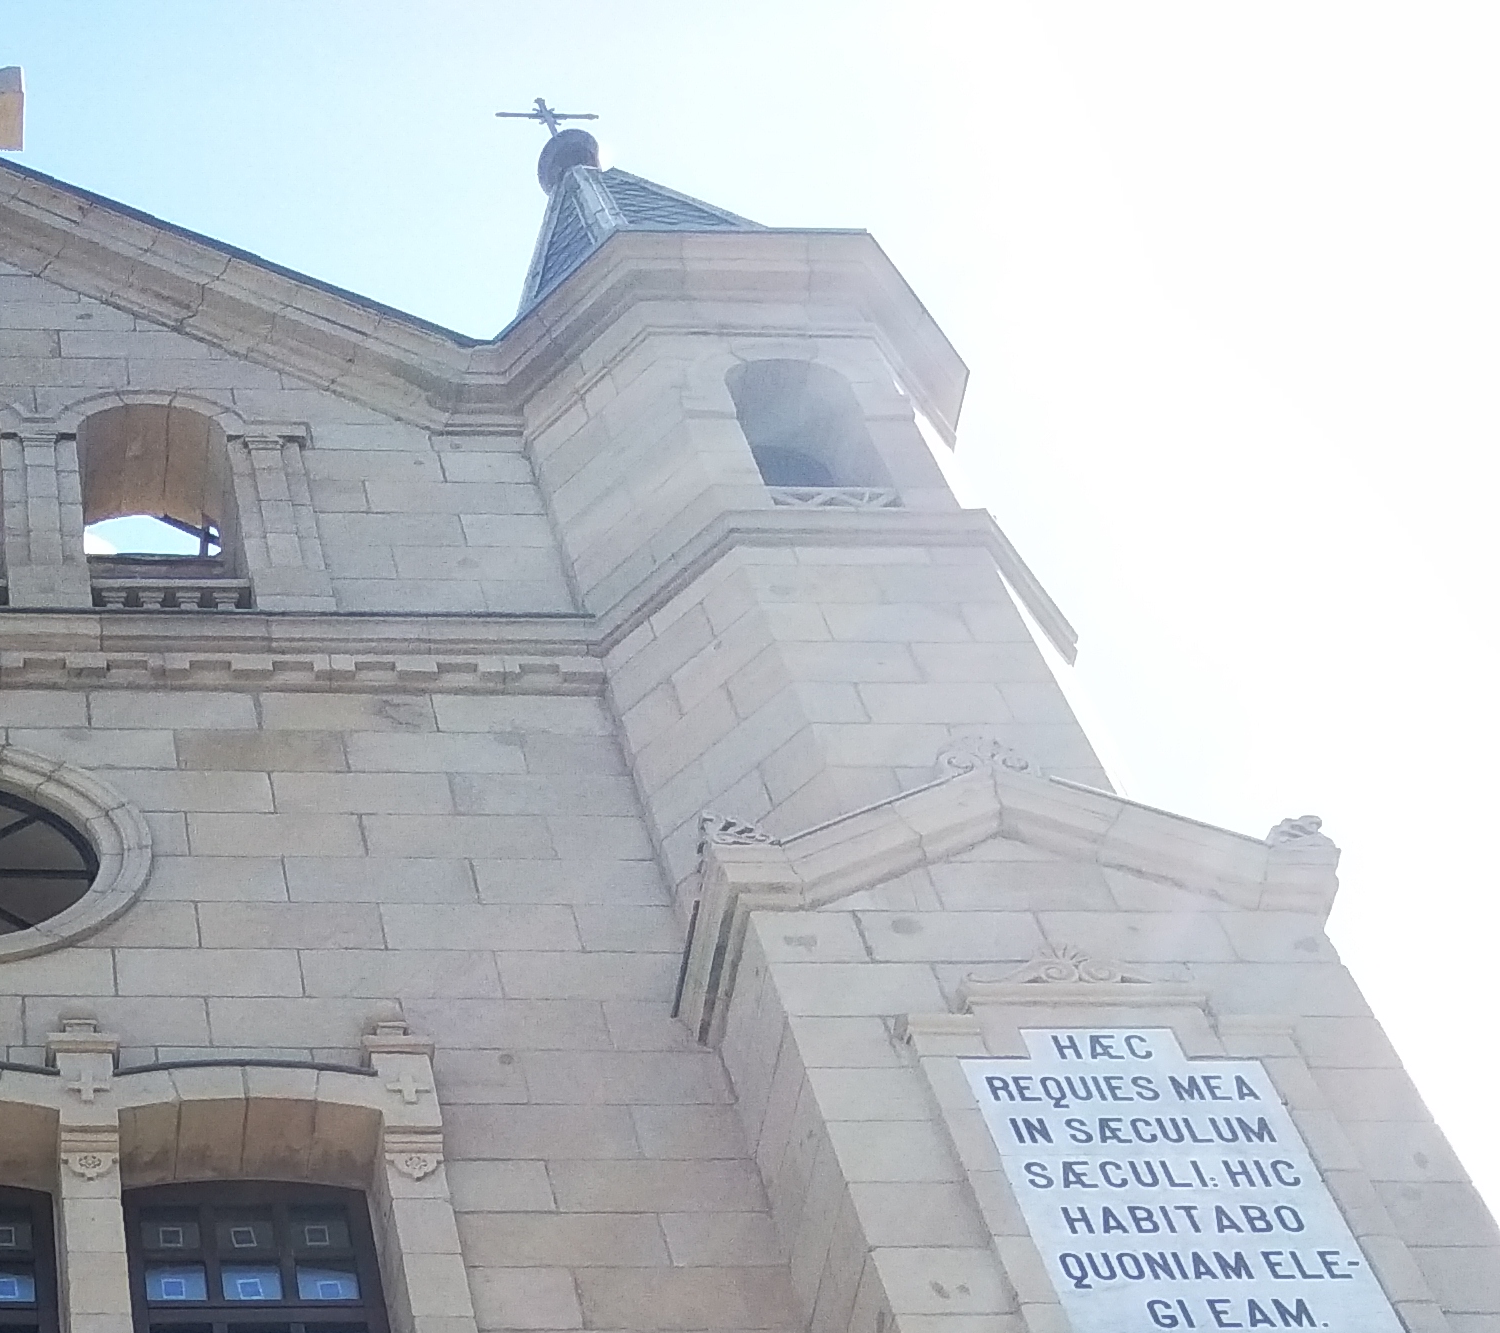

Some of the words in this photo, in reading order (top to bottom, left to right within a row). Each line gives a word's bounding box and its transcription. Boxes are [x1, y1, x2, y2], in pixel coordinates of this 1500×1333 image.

[1051, 1034, 1153, 1060] HÆC
[985, 1075, 1161, 1108] REQUIES
[1168, 1075, 1261, 1102] MEA
[1009, 1118, 1054, 1144] IN
[1064, 1117, 1277, 1144] SÆCULUM
[1224, 1160, 1302, 1188] HIC
[1061, 1206, 1305, 1234] HABITABO
[1059, 1251, 1255, 1288] QUONIAM
[1262, 1251, 1360, 1280] ELE-
[1147, 1299, 1196, 1329] GI
[1206, 1299, 1329, 1328] EAM.
